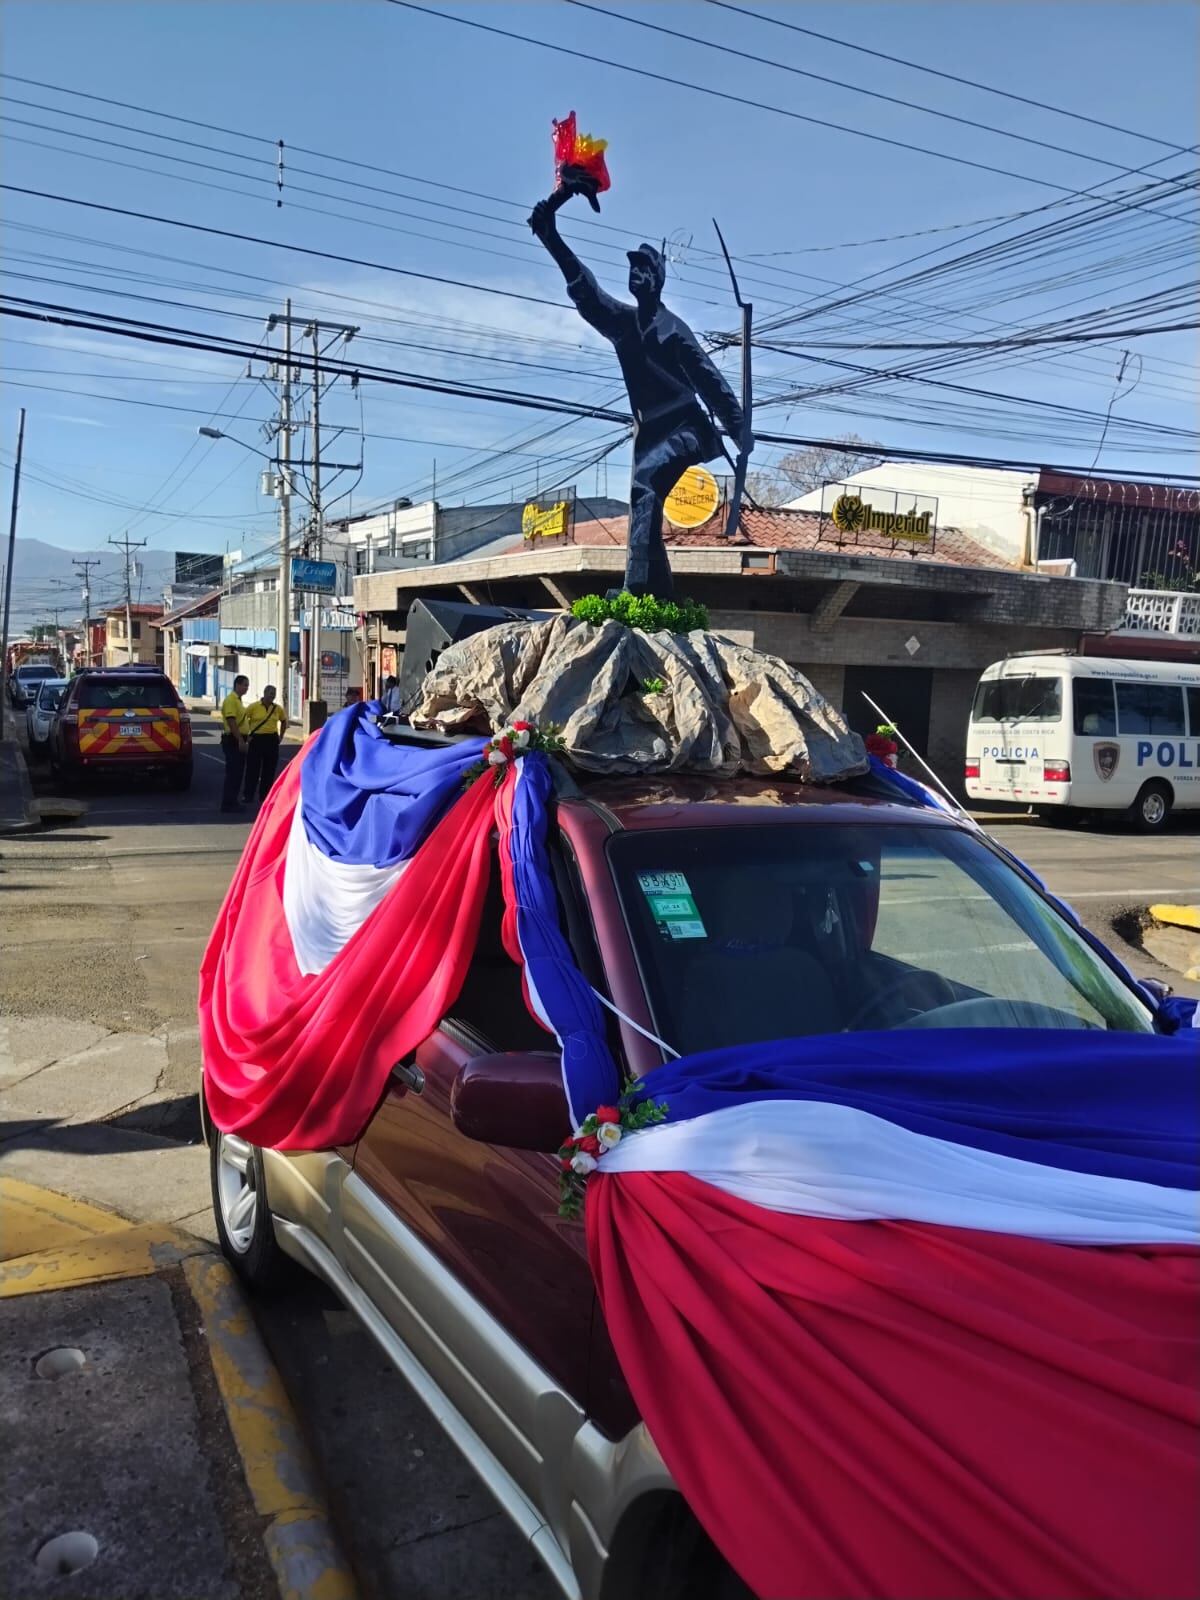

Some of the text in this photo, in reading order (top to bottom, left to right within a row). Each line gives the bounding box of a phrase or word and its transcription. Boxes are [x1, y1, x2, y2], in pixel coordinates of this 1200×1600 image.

[675, 494, 715, 506] CERVECERA
[862, 503, 933, 535] Imperial
[304, 611, 326, 627] OPA
[983, 746, 1039, 758] POLICIA
